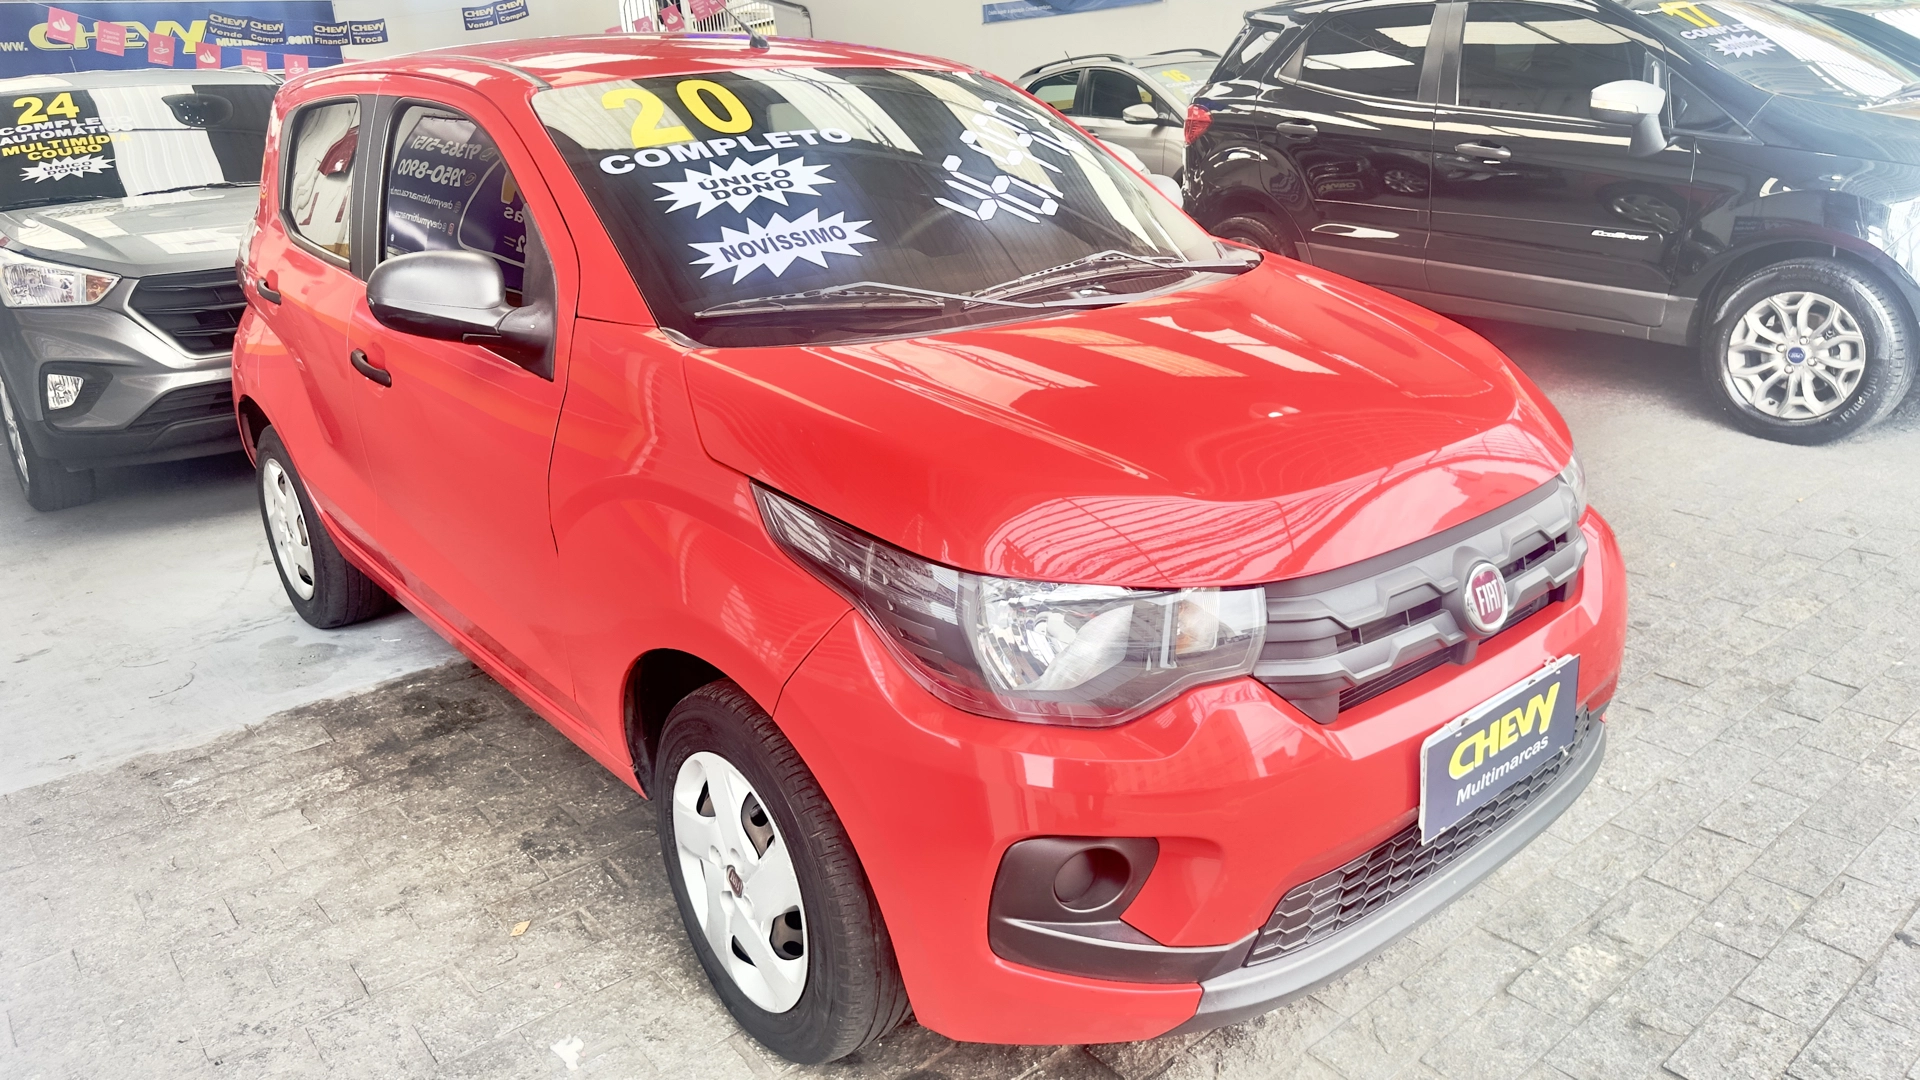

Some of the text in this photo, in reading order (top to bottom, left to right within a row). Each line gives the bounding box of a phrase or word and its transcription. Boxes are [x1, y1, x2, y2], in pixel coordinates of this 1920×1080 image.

[464, 6, 494, 18] CHEVY
[500, 11, 526, 22] Compra
[1657, 1, 1721, 28] 17
[209, 14, 248, 28] CHEVY
[250, 21, 284, 32] CHEVY
[314, 25, 348, 34] CHEVY
[351, 22, 384, 32] CHEVY
[467, 20, 494, 29] Vende
[209, 26, 243, 38] Vende
[250, 33, 284, 44] Compra
[354, 36, 383, 44] Troca
[1680, 23, 1750, 40] COMPLE
[314, 37, 348, 45] Financia
[1161, 69, 1192, 83] 16
[13, 92, 80, 125] 24
[601, 79, 753, 149] 20
[0, 115, 133, 136] COMPLETO
[0, 124, 134, 146] AUTOMÁTICO
[2, 132, 133, 157] MULTIMÍDIA
[28, 144, 102, 161] COURO
[599, 128, 852, 175] COMPLETO
[47, 166, 91, 176] DONO
[697, 168, 791, 191] ÚNICO
[711, 179, 794, 200] DONO
[718, 225, 847, 263] NOVÍSSIMO
[1475, 578, 1501, 616] FIAT
[1448, 681, 1560, 780] CHEVY
[1456, 735, 1549, 806] Multimarcas
